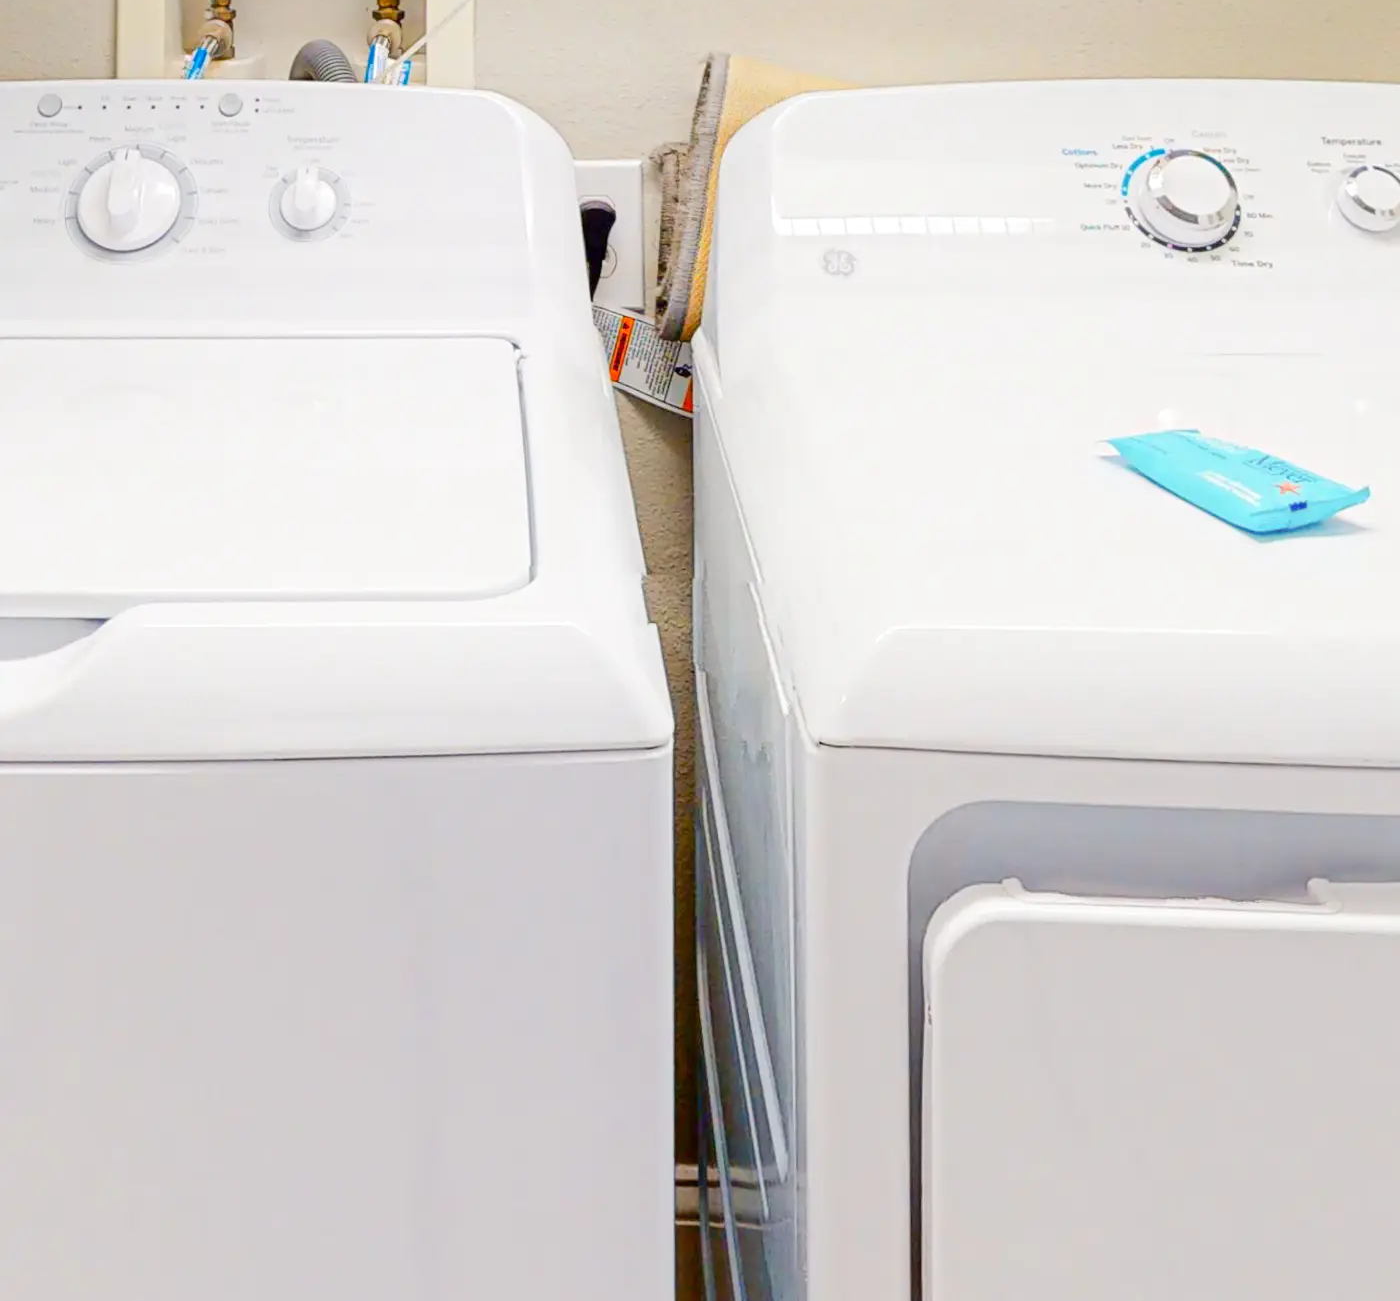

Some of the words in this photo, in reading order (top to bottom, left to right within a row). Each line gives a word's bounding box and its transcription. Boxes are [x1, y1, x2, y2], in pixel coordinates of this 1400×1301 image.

[1321, 136, 1382, 147] Temperature
[1130, 143, 1144, 151] Dry
[1223, 147, 1237, 155] Dry
[1061, 147, 1098, 156] Cottons
[1237, 157, 1250, 165] Dry
[1110, 162, 1124, 171] Dry
[1104, 182, 1117, 190] Dry
[1231, 259, 1255, 268] Time
[1256, 260, 1274, 269] Dry
